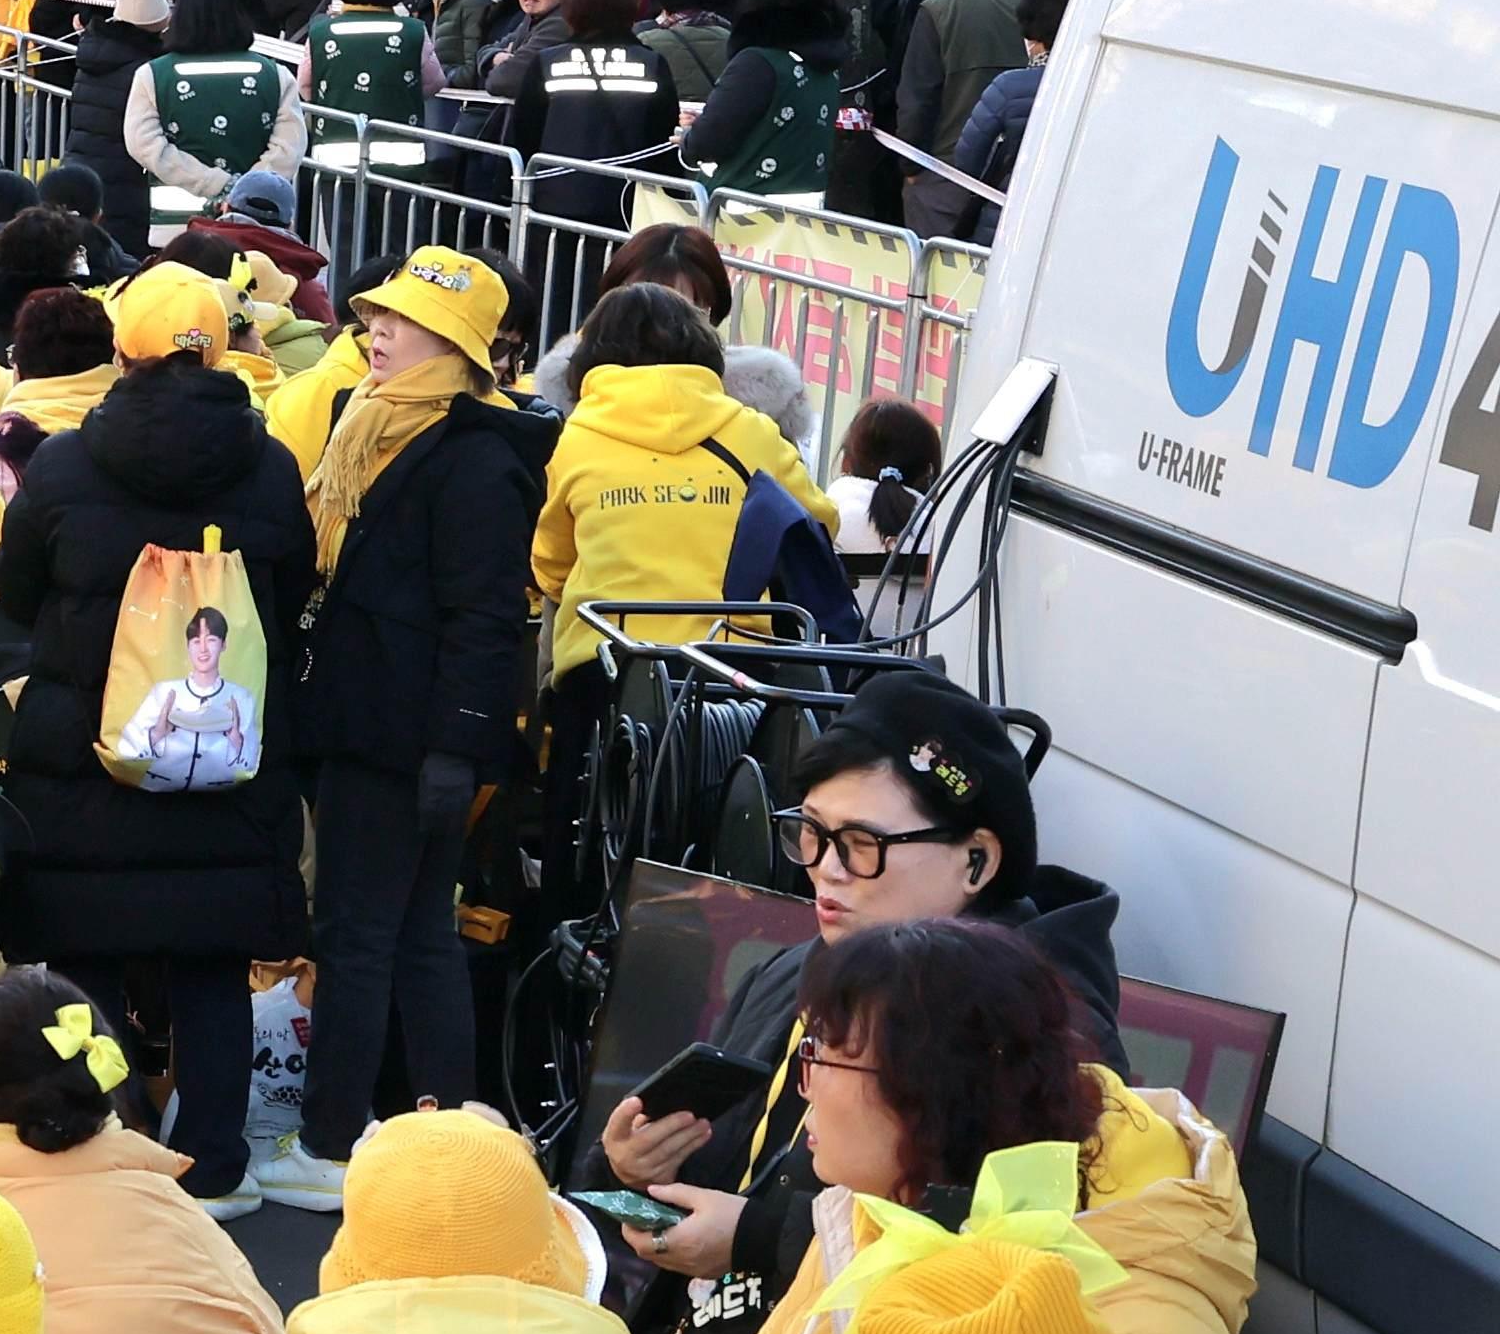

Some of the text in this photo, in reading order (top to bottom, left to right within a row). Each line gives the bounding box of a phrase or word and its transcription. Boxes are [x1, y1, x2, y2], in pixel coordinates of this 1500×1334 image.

[1165, 135, 1460, 490] UHD
[600, 486, 646, 509] PARK
[703, 485, 731, 507] JIN
[1137, 431, 1227, 498] U-FRAME
